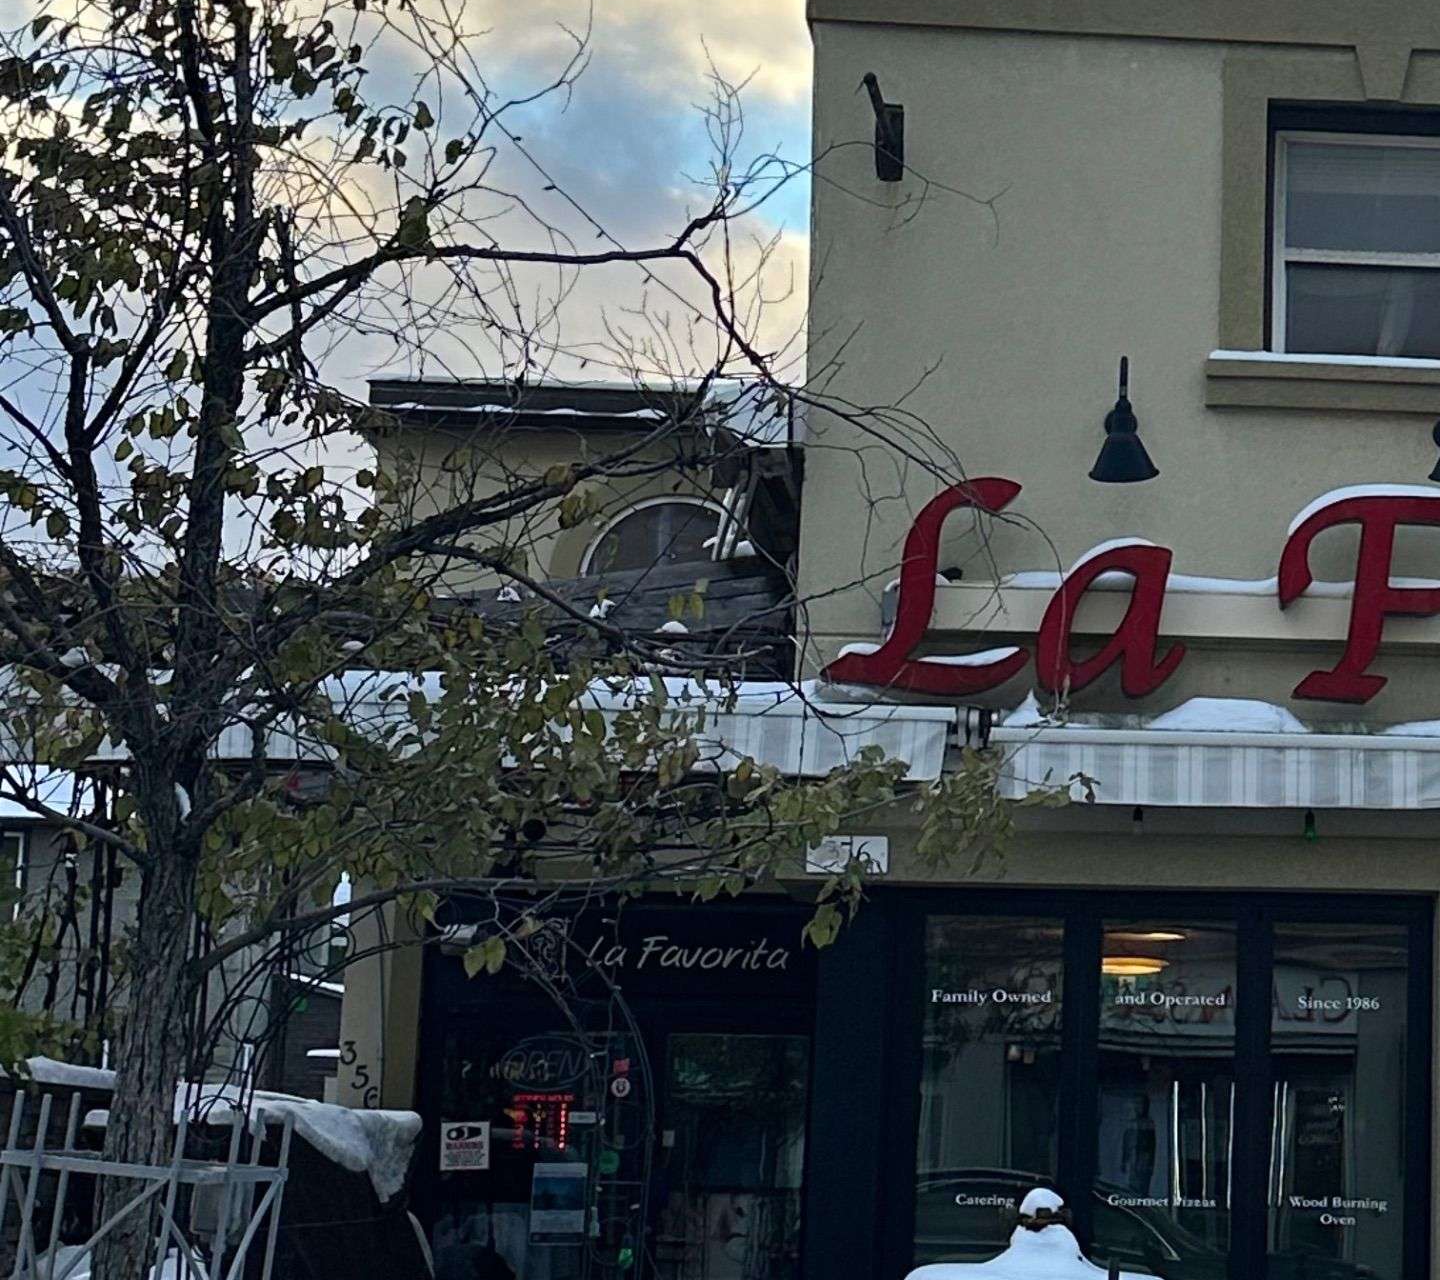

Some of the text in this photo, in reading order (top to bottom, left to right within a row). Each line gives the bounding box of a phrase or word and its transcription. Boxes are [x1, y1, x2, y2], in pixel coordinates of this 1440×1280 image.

[819, 476, 1187, 699] La
[586, 936, 790, 969] La Favorita
[931, 988, 1053, 1007] Family Owned
[1116, 991, 1226, 1009] and Operated
[1298, 995, 1381, 1011] Since 1986
[955, 1193, 1015, 1210] Catering
[1107, 1194, 1168, 1208] Gourmet
[1288, 1195, 1388, 1213] Wood Burning
[1319, 1213, 1357, 1226] Oven
